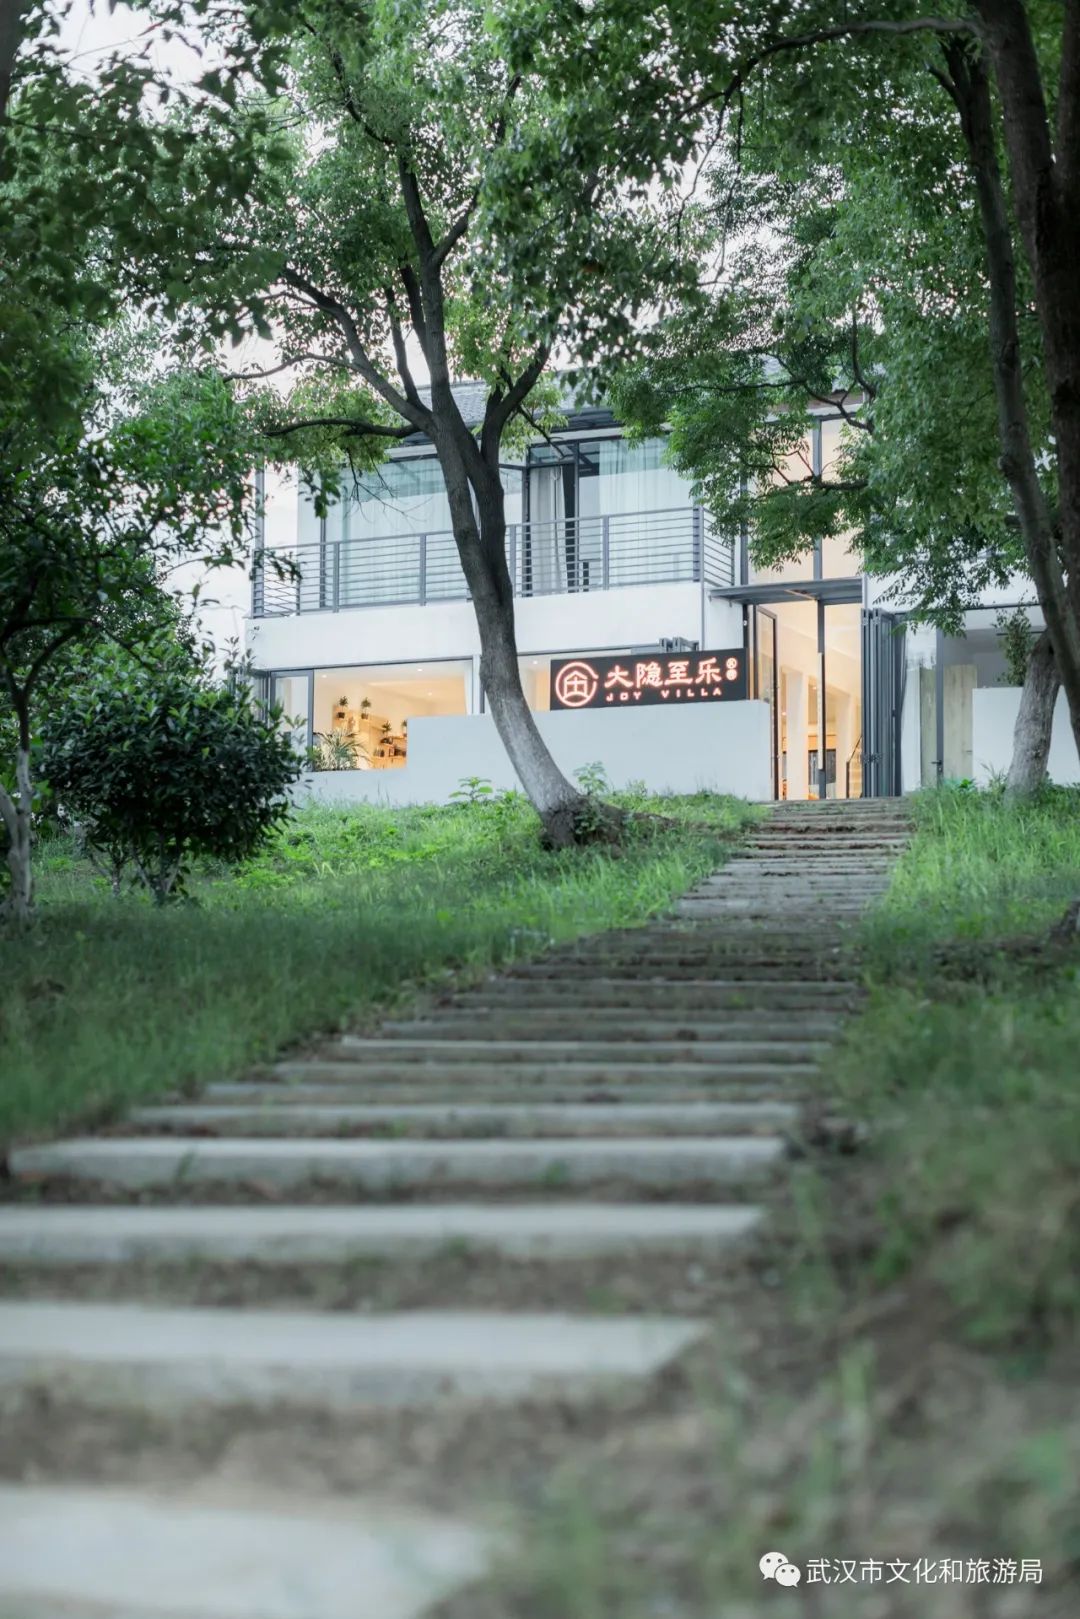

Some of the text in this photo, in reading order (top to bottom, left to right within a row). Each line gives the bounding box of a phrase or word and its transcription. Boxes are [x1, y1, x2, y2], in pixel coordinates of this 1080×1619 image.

[604, 657, 722, 688] 大隐至乐
[606, 687, 722, 702] JOY VILLA
